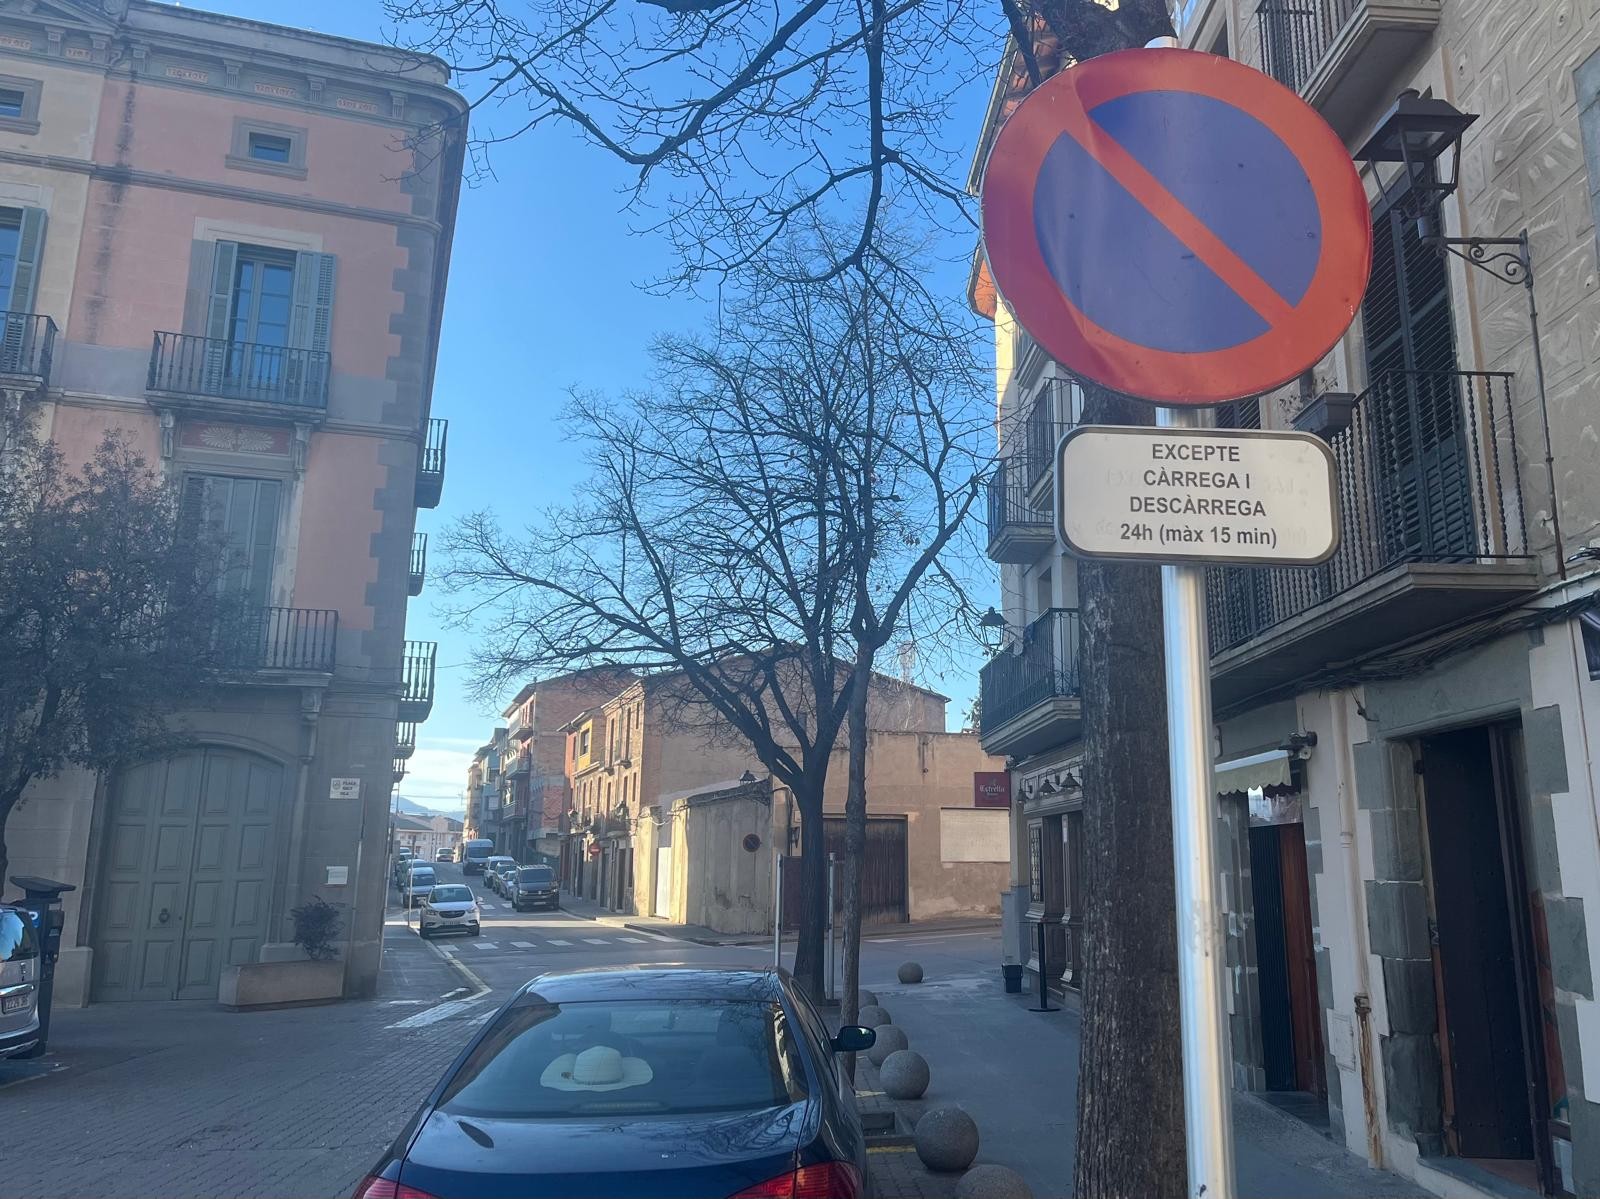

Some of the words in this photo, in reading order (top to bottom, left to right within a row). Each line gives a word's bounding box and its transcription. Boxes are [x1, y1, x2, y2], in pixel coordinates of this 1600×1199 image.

[1152, 443, 1241, 462] EXCEPTE
[1143, 467, 1241, 489] CÀRREGA
[1245, 473, 1250, 490] I
[1130, 493, 1267, 517] DESCÀRREGA
[1120, 523, 1153, 541] 24h
[1159, 523, 1204, 546] (màx
[1210, 526, 1231, 544] 15
[1236, 527, 1277, 550] min)
[979, 784, 1005, 793] Estrella
